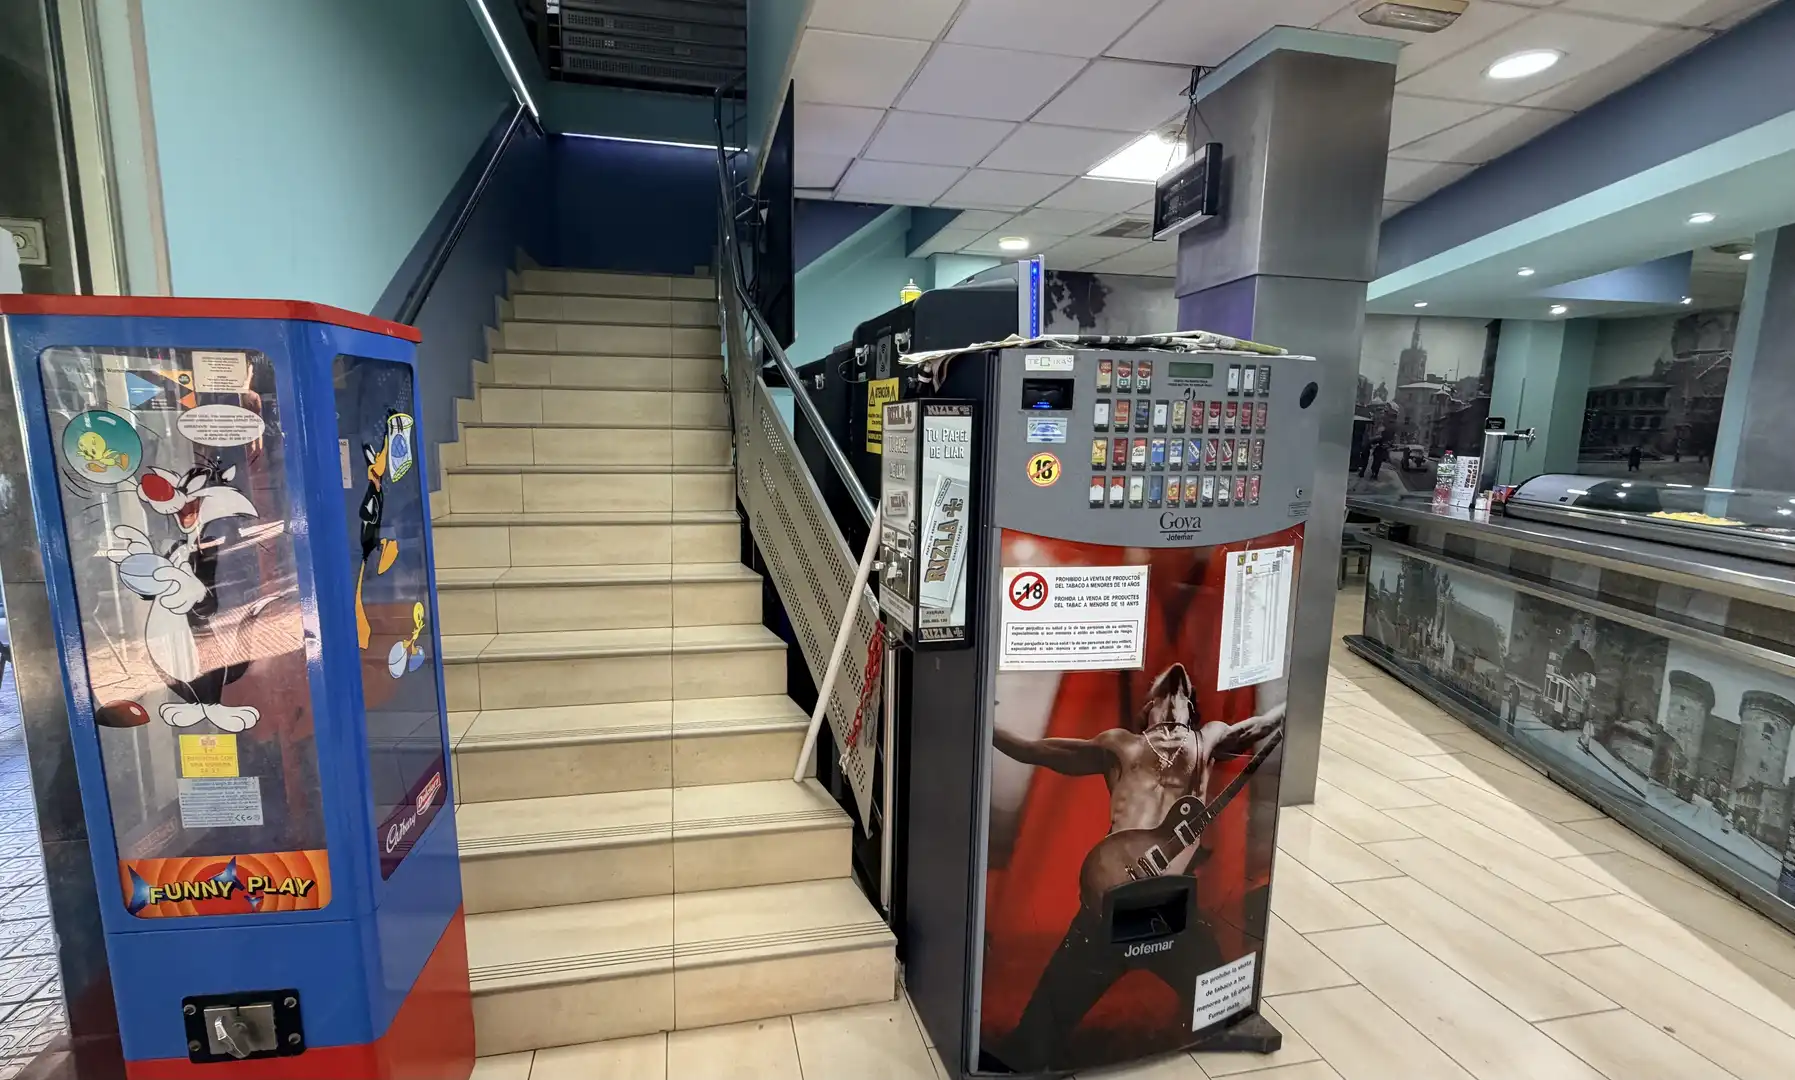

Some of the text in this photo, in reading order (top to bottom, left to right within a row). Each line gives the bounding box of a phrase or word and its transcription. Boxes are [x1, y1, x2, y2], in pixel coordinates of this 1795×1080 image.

[926, 427, 968, 442] TU PAPEL
[929, 445, 964, 459] DE LIAR
[1160, 512, 1202, 531] Goya
[1015, 583, 1043, 599] -18
[150, 876, 316, 905] FUNNY PLAY
[1124, 940, 1174, 957] Jofemar
